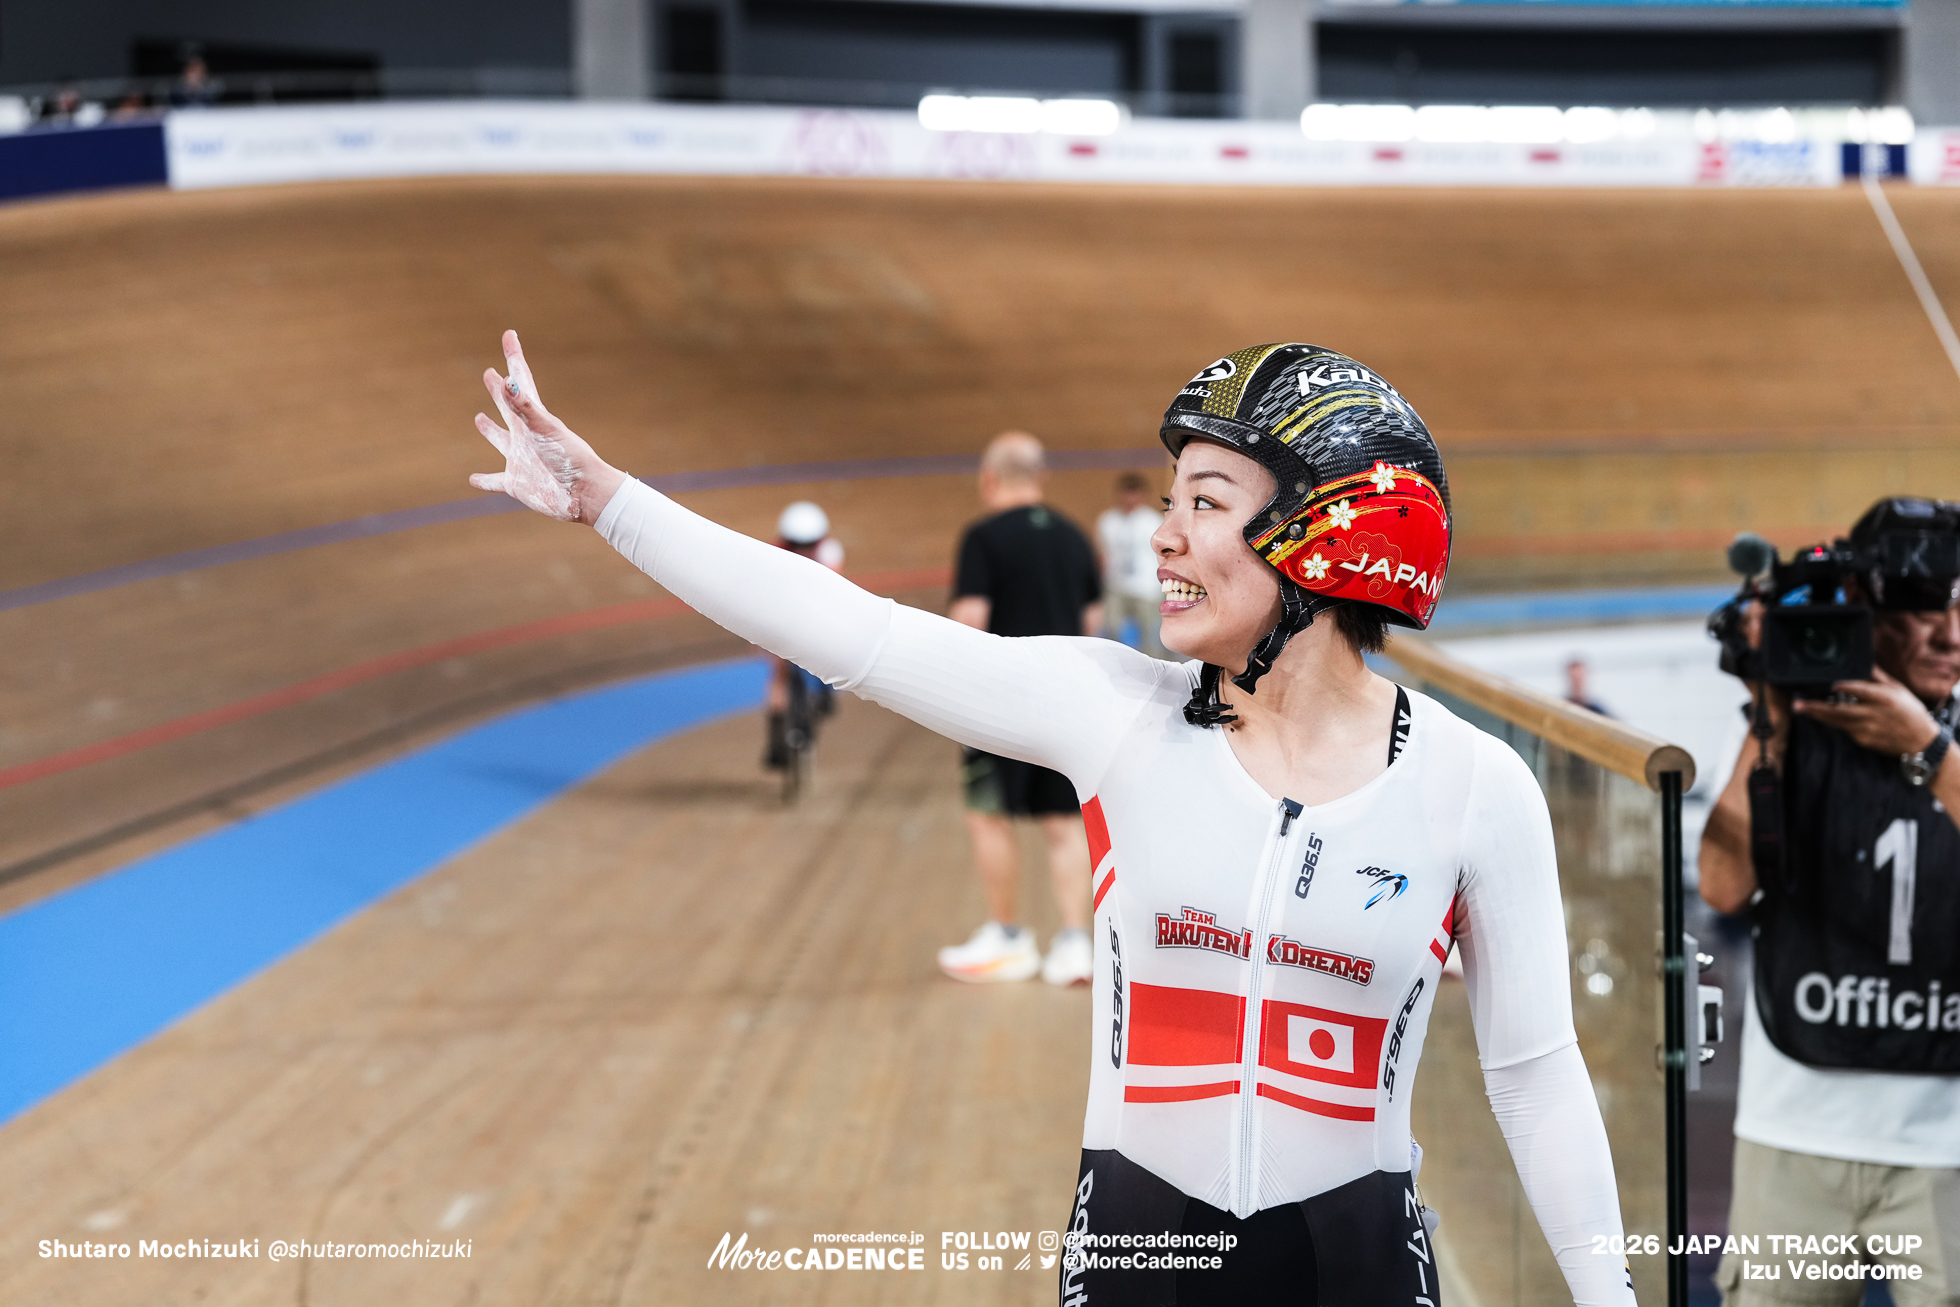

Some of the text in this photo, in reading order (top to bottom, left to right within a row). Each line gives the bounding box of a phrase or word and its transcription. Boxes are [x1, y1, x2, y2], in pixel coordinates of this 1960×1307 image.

[1339, 553, 1441, 599] JAPAN
[1356, 866, 1391, 877] JCF
[1874, 818, 1918, 965] 1
[1183, 909, 1213, 925] TEAM
[1157, 916, 1241, 953] RAKUTEN
[1281, 941, 1374, 984] DREAMS
